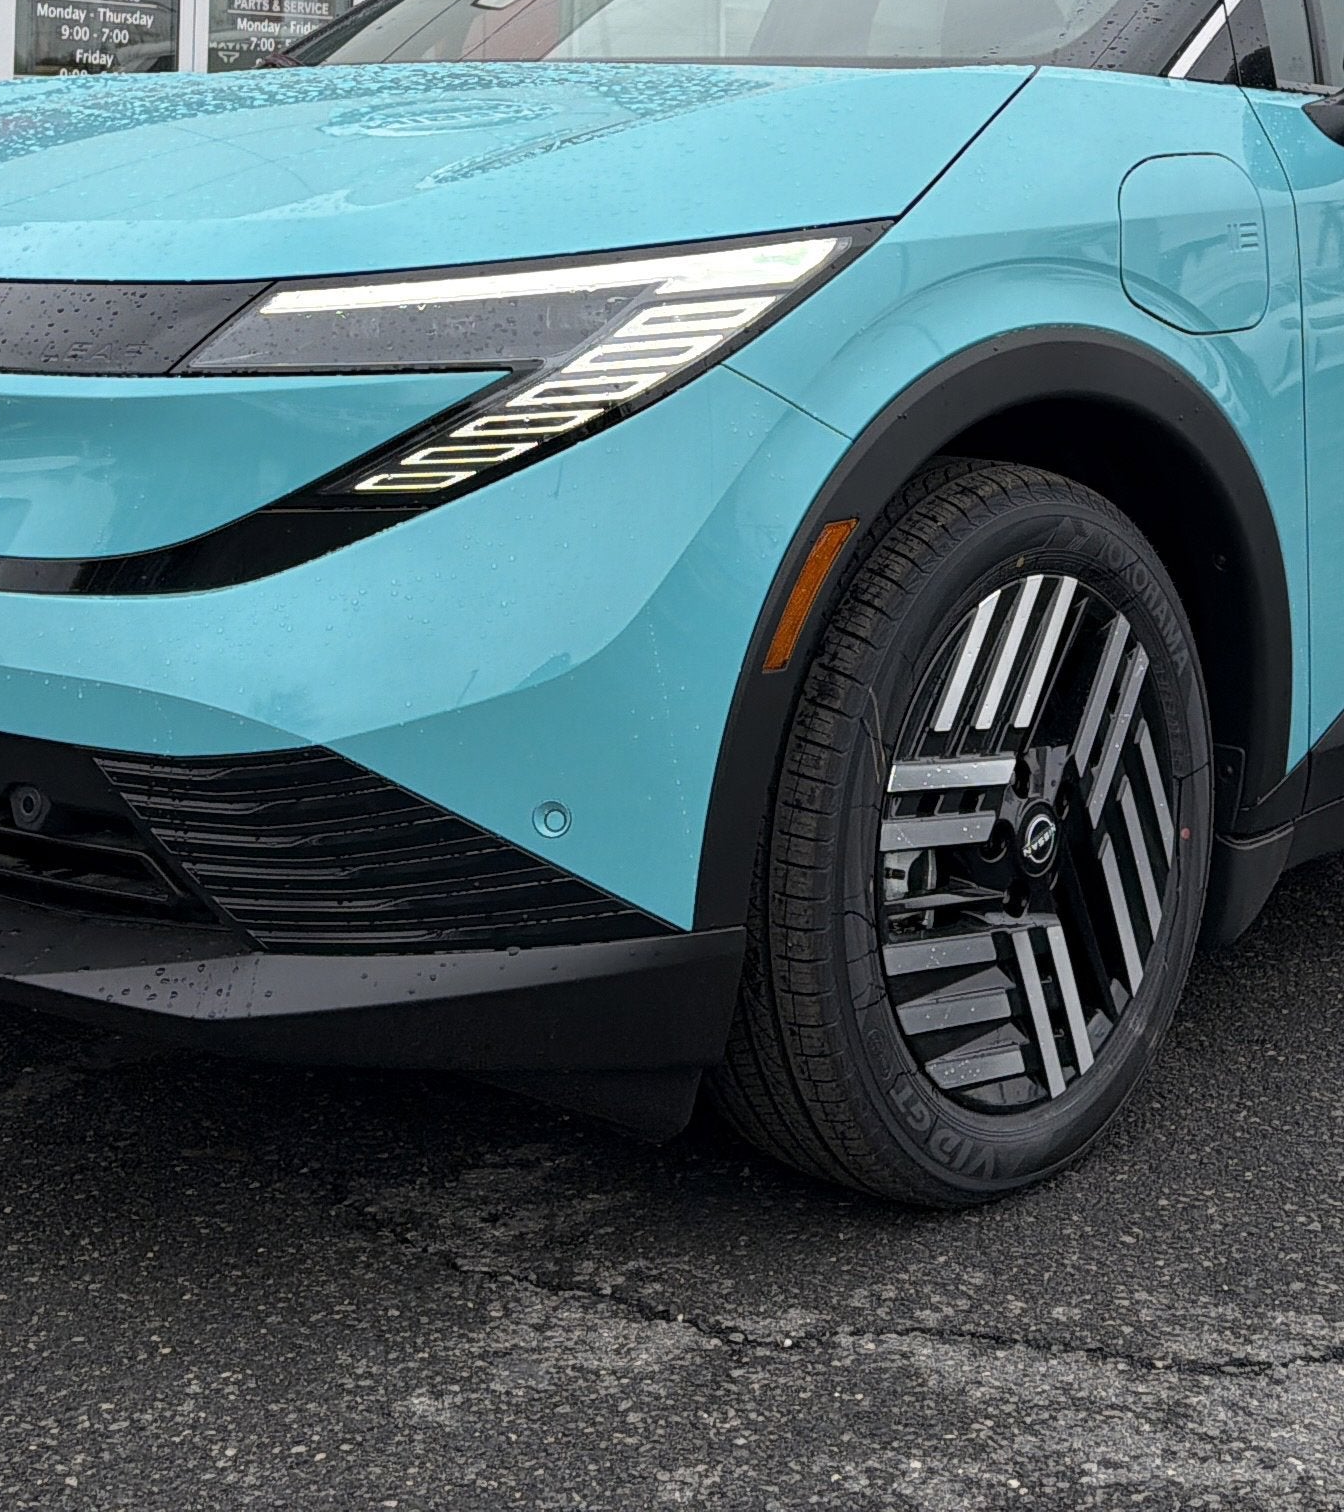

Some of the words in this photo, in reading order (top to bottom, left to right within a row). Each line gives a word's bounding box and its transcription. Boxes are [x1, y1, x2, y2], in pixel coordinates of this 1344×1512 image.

[36, 2, 87, 23] Monday
[97, 7, 154, 28] Thursday
[272, 0, 281, 11] &
[283, 1, 329, 15] SERVICE
[61, 25, 89, 40] 9:00
[101, 28, 129, 44] 7:00
[236, 18, 281, 35] Monday
[250, 37, 275, 52] 7:00
[75, 49, 114, 68] Friday
